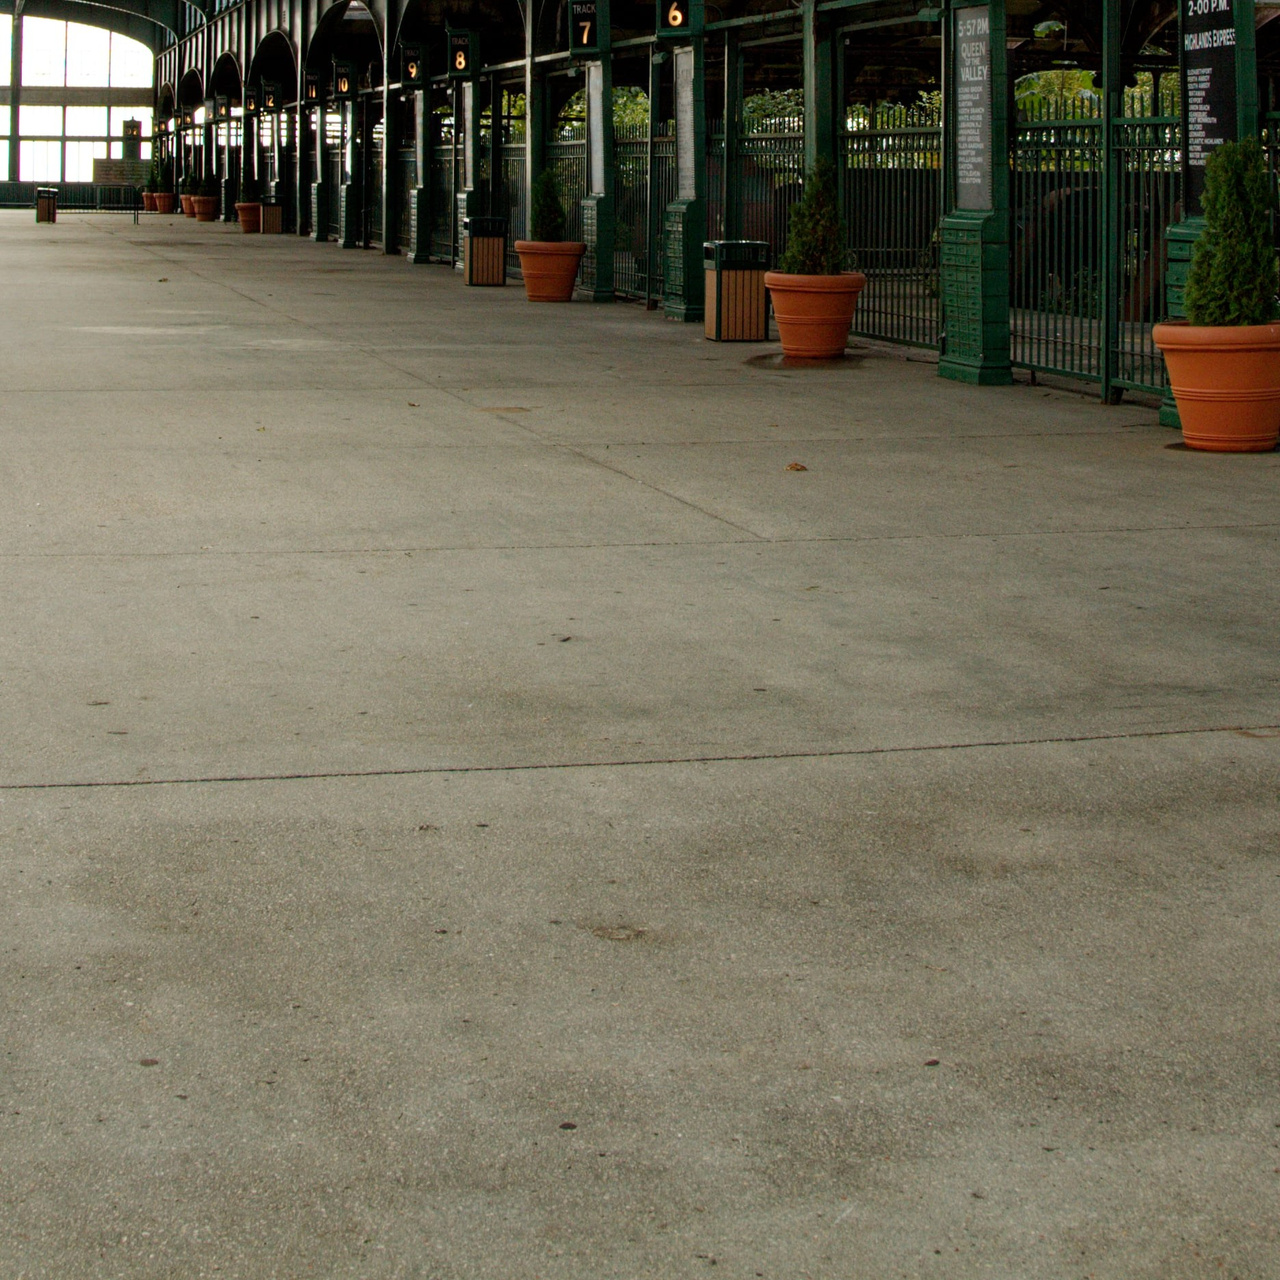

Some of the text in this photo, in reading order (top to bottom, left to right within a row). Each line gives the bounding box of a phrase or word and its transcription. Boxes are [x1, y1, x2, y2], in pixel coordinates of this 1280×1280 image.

[572, 4, 597, 15] TRACK
[668, 1, 683, 26] 6
[578, 21, 591, 45] 7
[1184, 28, 1236, 51] HIGHLANDS EXPRESS
[961, 41, 986, 59] QUEEN
[455, 50, 466, 70] 8
[408, 61, 417, 79] 9
[960, 65, 988, 82] VALLEY
[337, 77, 349, 93] 10
[246, 98, 255, 110] 13
[265, 95, 275, 107] 12
